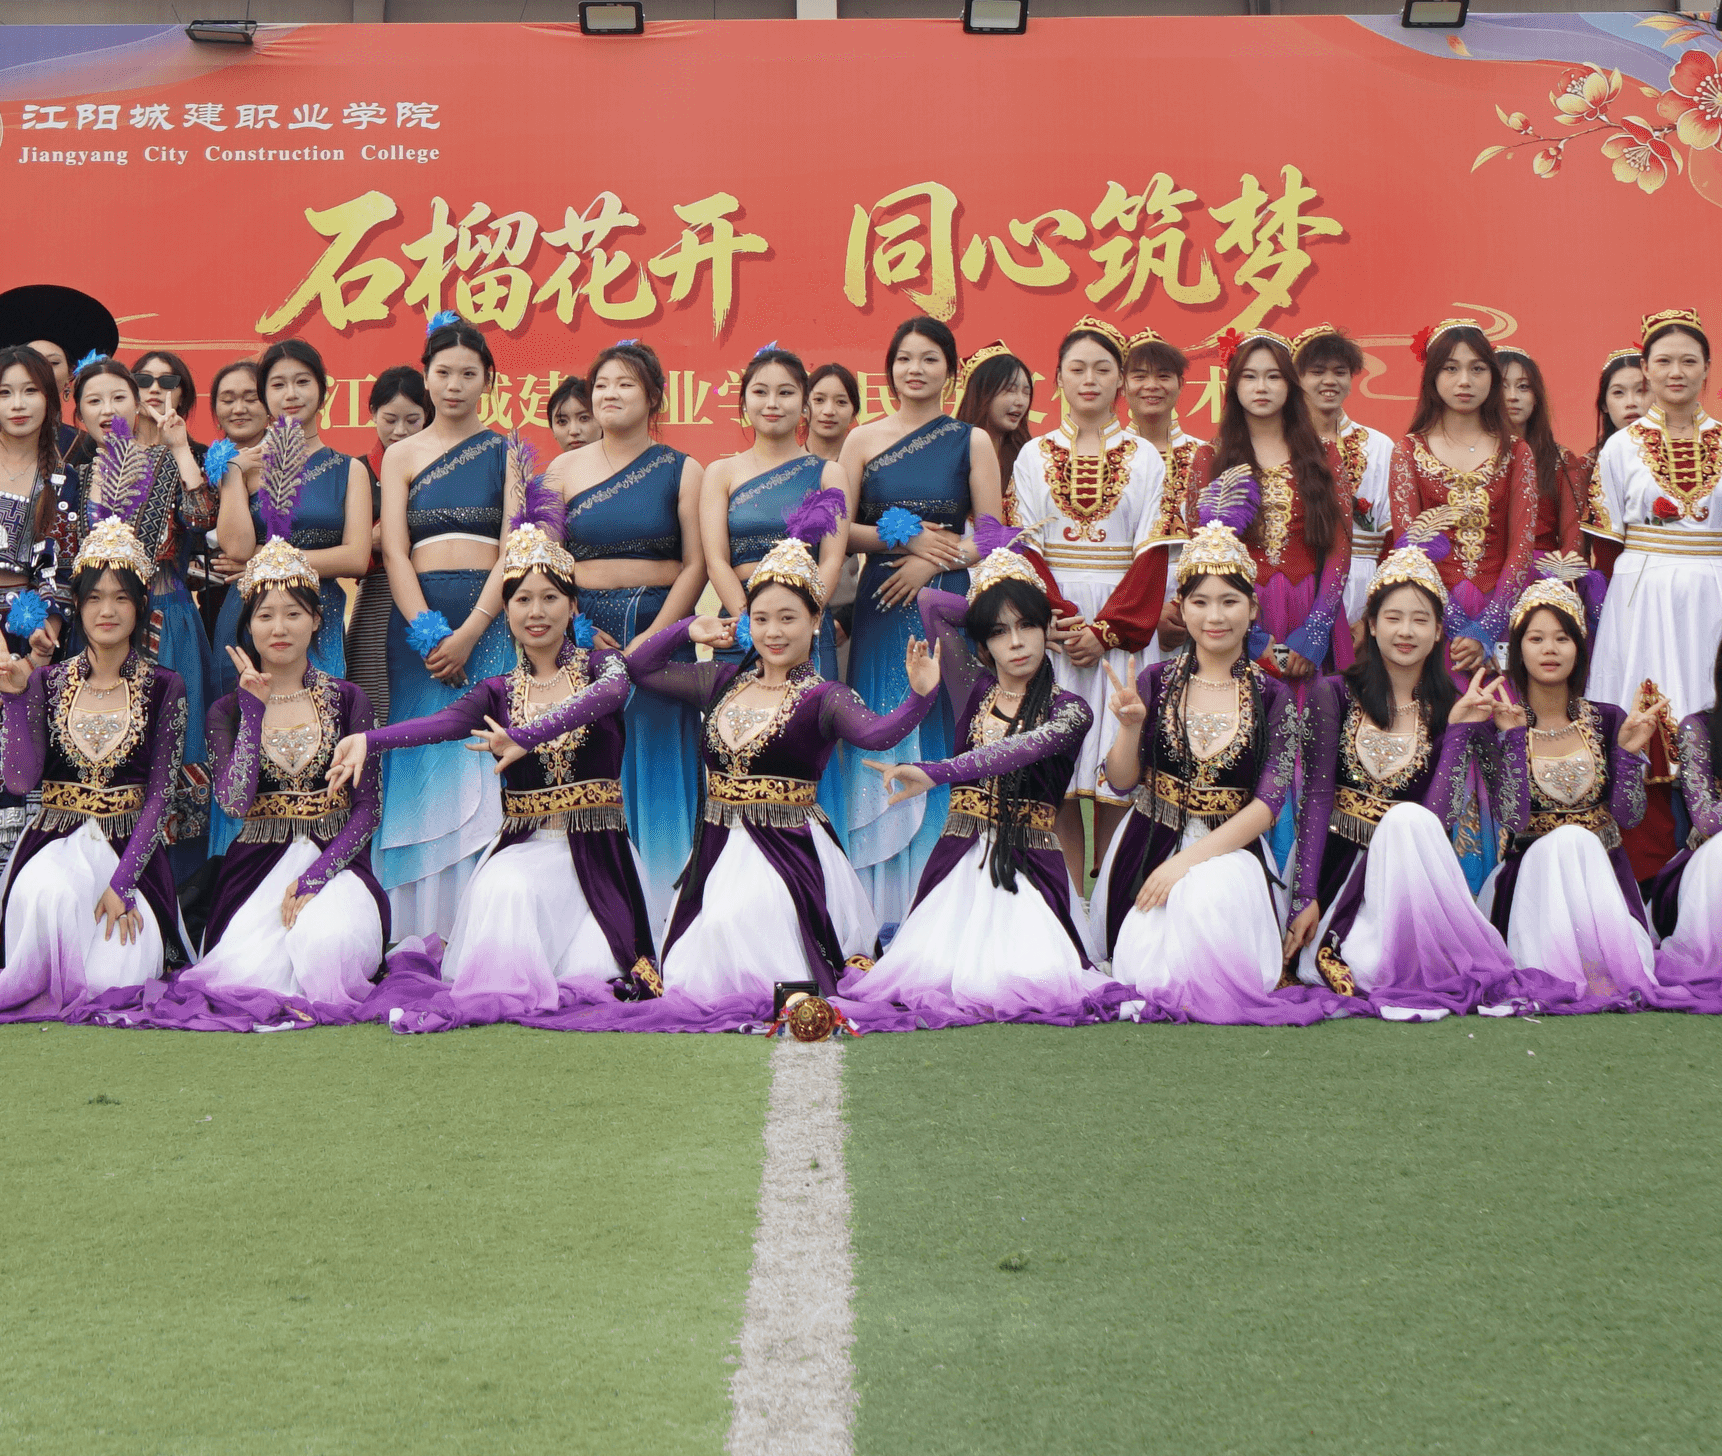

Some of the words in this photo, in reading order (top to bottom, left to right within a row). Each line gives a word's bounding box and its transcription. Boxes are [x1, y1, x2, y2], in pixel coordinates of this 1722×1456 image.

[21, 102, 441, 131] 江阳城建职业学院
[19, 146, 128, 165] Jiangyang
[143, 146, 189, 165] City
[205, 145, 345, 162] Construction
[360, 144, 440, 163] College
[255, 190, 769, 339] 石榴花开
[844, 164, 1344, 352] 同心筑梦
